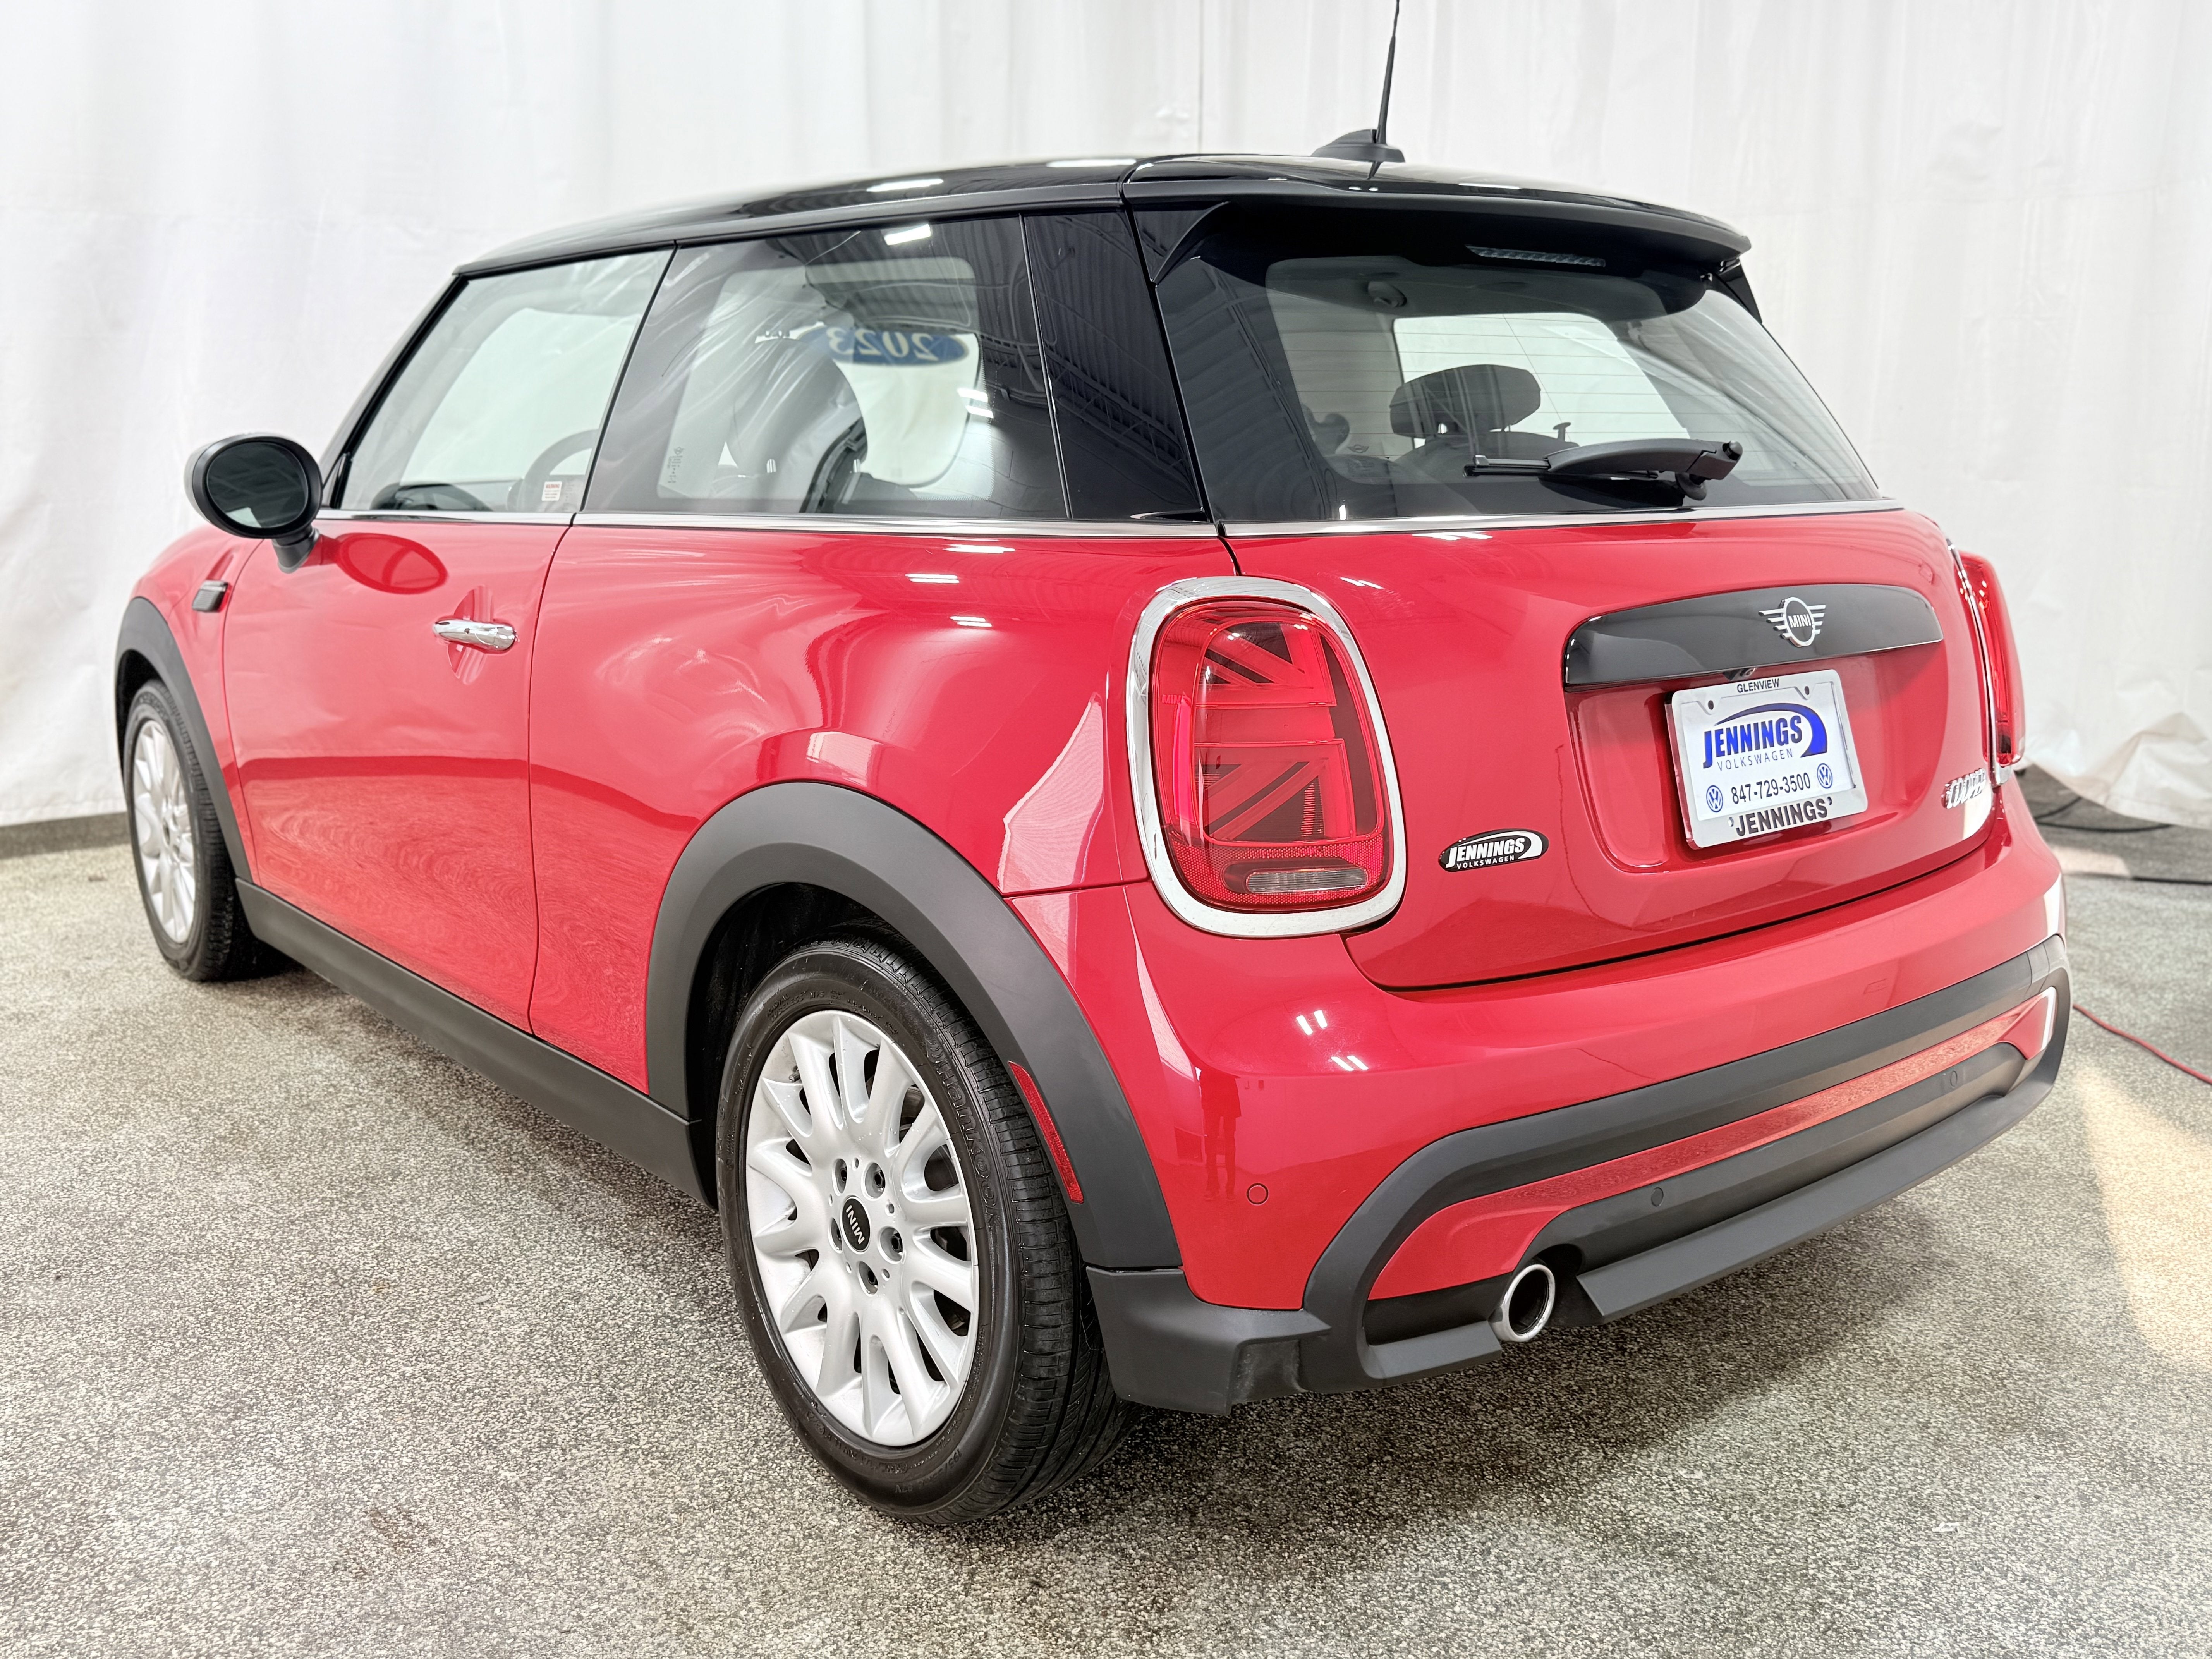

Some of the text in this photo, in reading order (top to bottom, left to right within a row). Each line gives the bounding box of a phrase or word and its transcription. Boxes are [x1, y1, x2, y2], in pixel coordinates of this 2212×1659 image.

[1788, 614, 1812, 628] MINI
[1737, 678, 1780, 693] GLENVIEW
[1703, 715, 1803, 769] JENNINGS
[1717, 748, 1793, 771] VOLKSWAGEN
[1731, 772, 1810, 804] 847-729-3500
[1446, 837, 1525, 868] JENNINGS
[1456, 855, 1515, 869] VOLKSWAGEN
[846, 1205, 865, 1244] MINI
